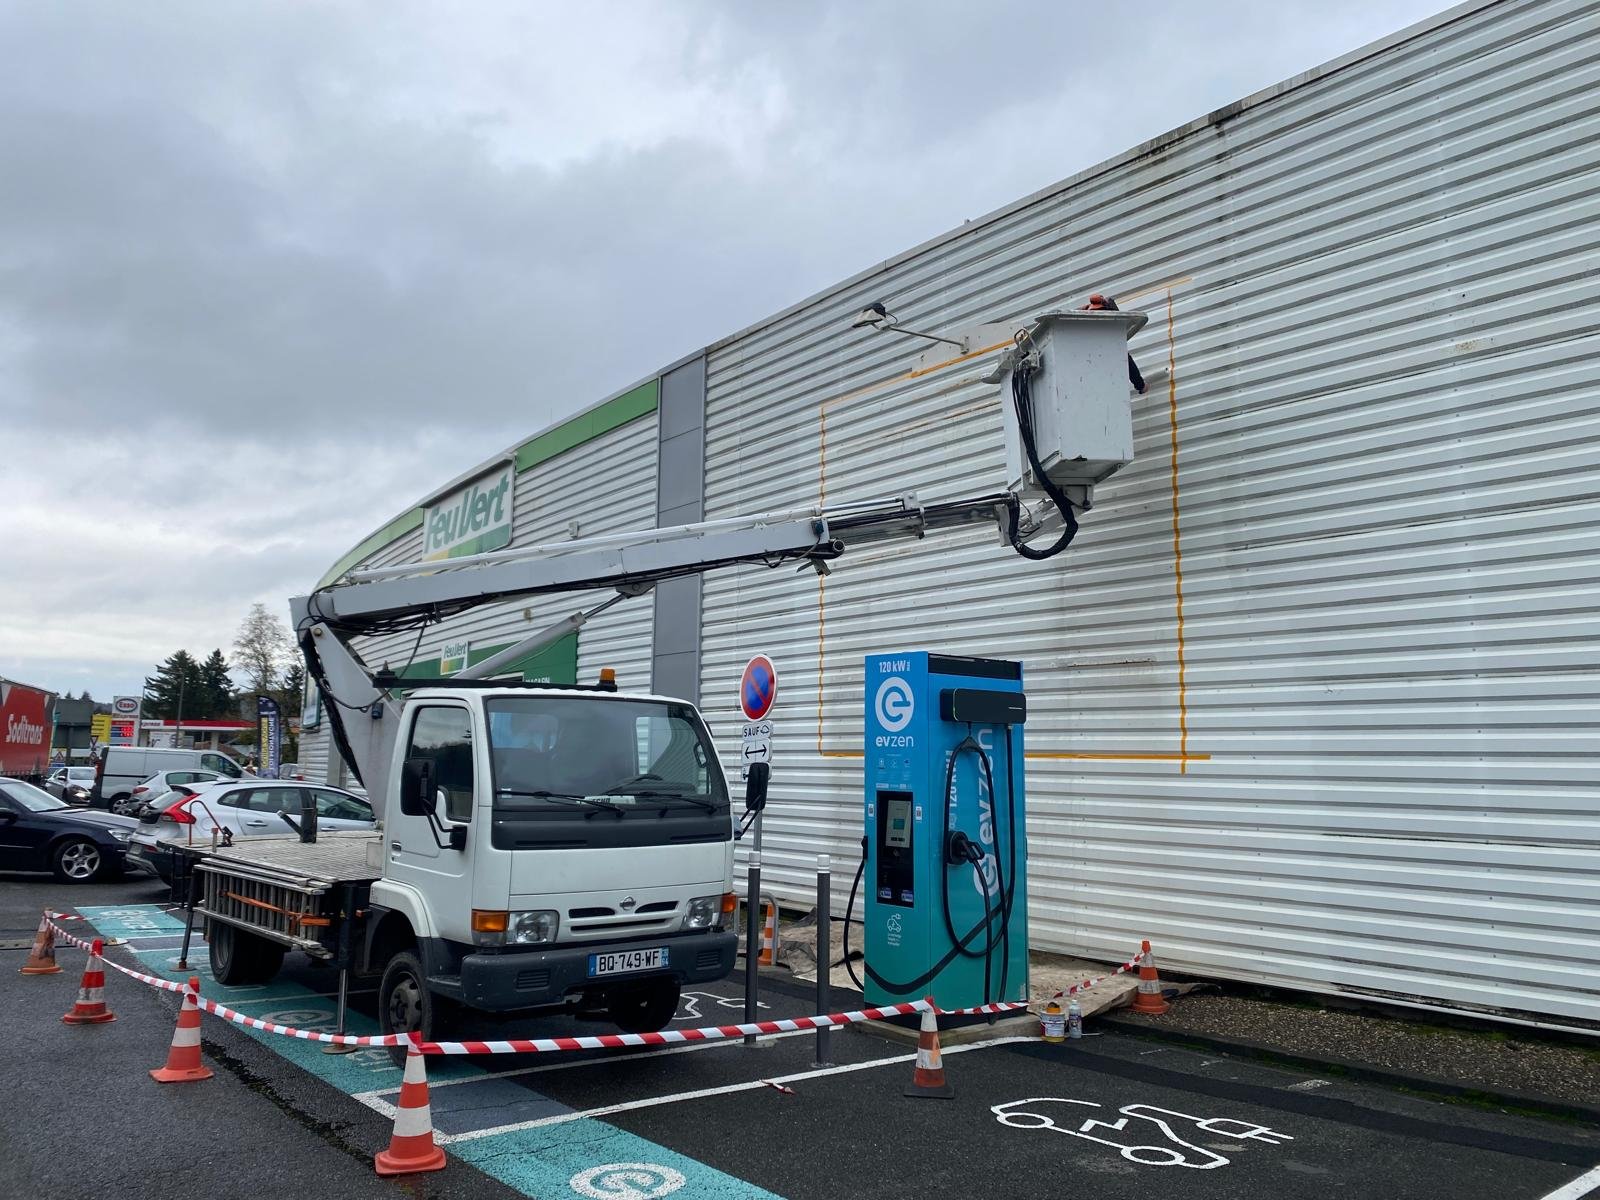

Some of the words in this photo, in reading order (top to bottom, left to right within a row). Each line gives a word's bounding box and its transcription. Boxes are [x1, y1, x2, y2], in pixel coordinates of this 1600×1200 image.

[879, 661, 891, 673] 120
[744, 726, 760, 738] SAUF
[875, 735, 914, 748] evzen
[599, 950, 660, 972] BQ-749-WF
